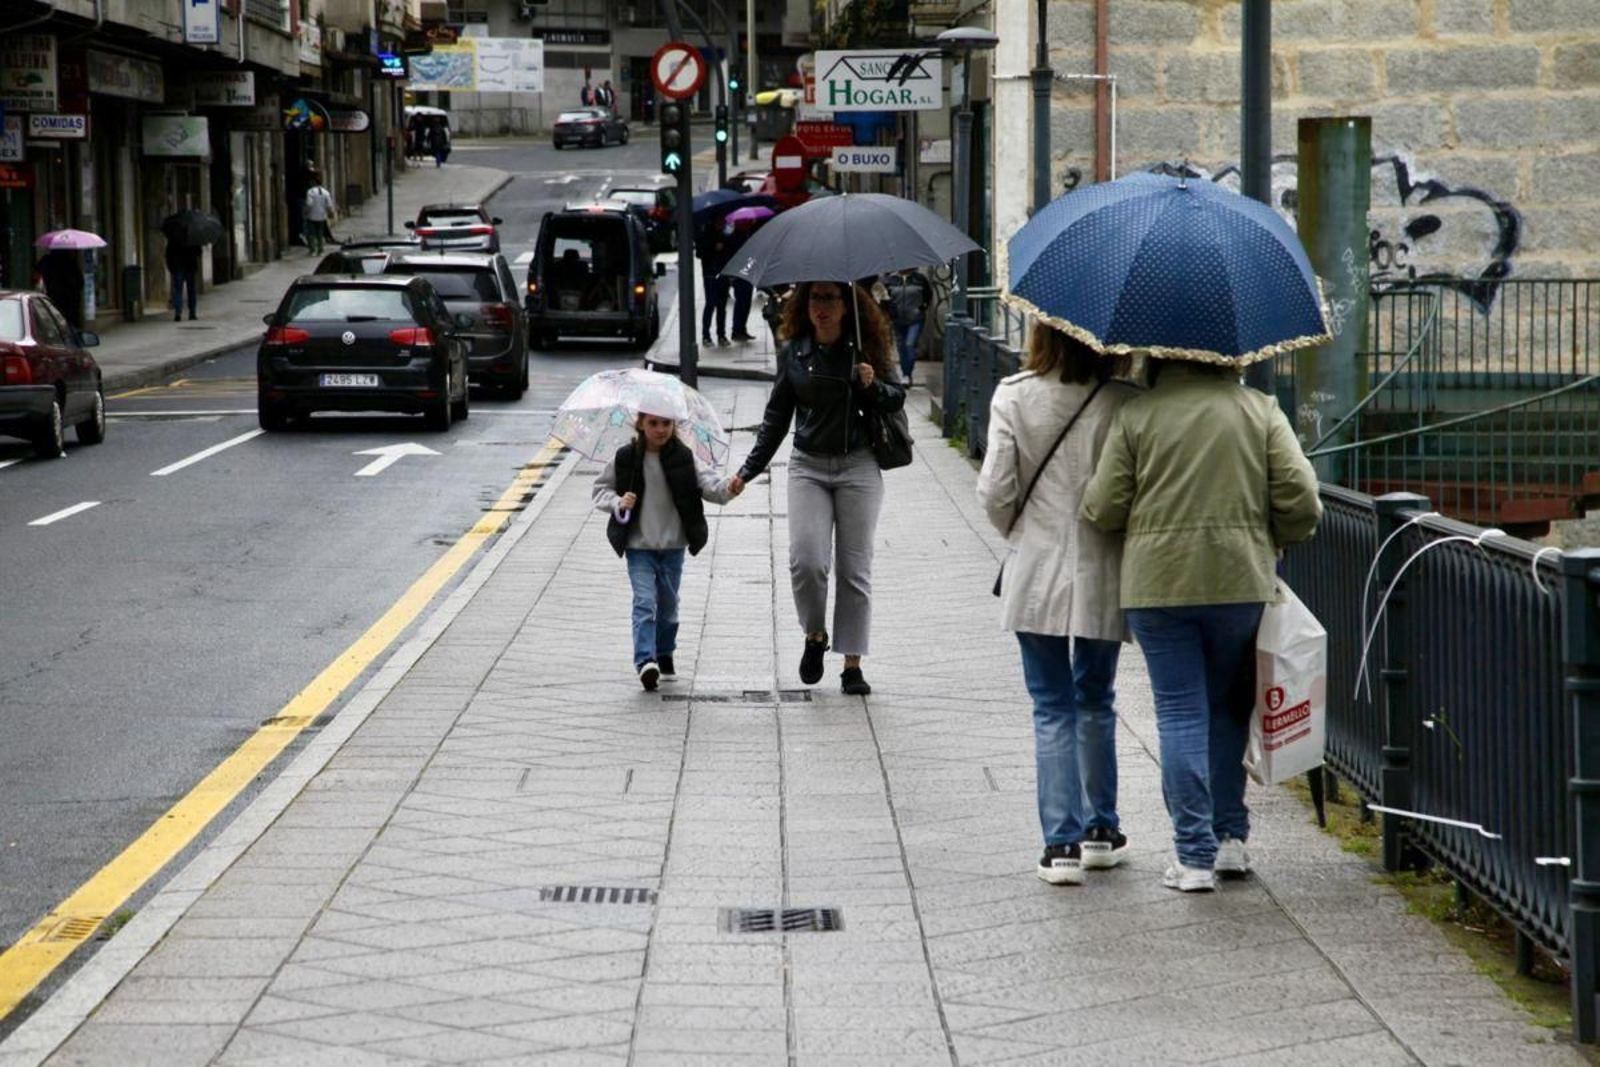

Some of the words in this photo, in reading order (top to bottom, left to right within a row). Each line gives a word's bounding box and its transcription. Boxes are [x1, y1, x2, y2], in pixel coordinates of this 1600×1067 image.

[32, 117, 84, 129] COMIDAS
[837, 153, 849, 165] O
[852, 153, 890, 165] BUXO
[326, 374, 352, 385] 2495
[1269, 690, 1280, 709] B
